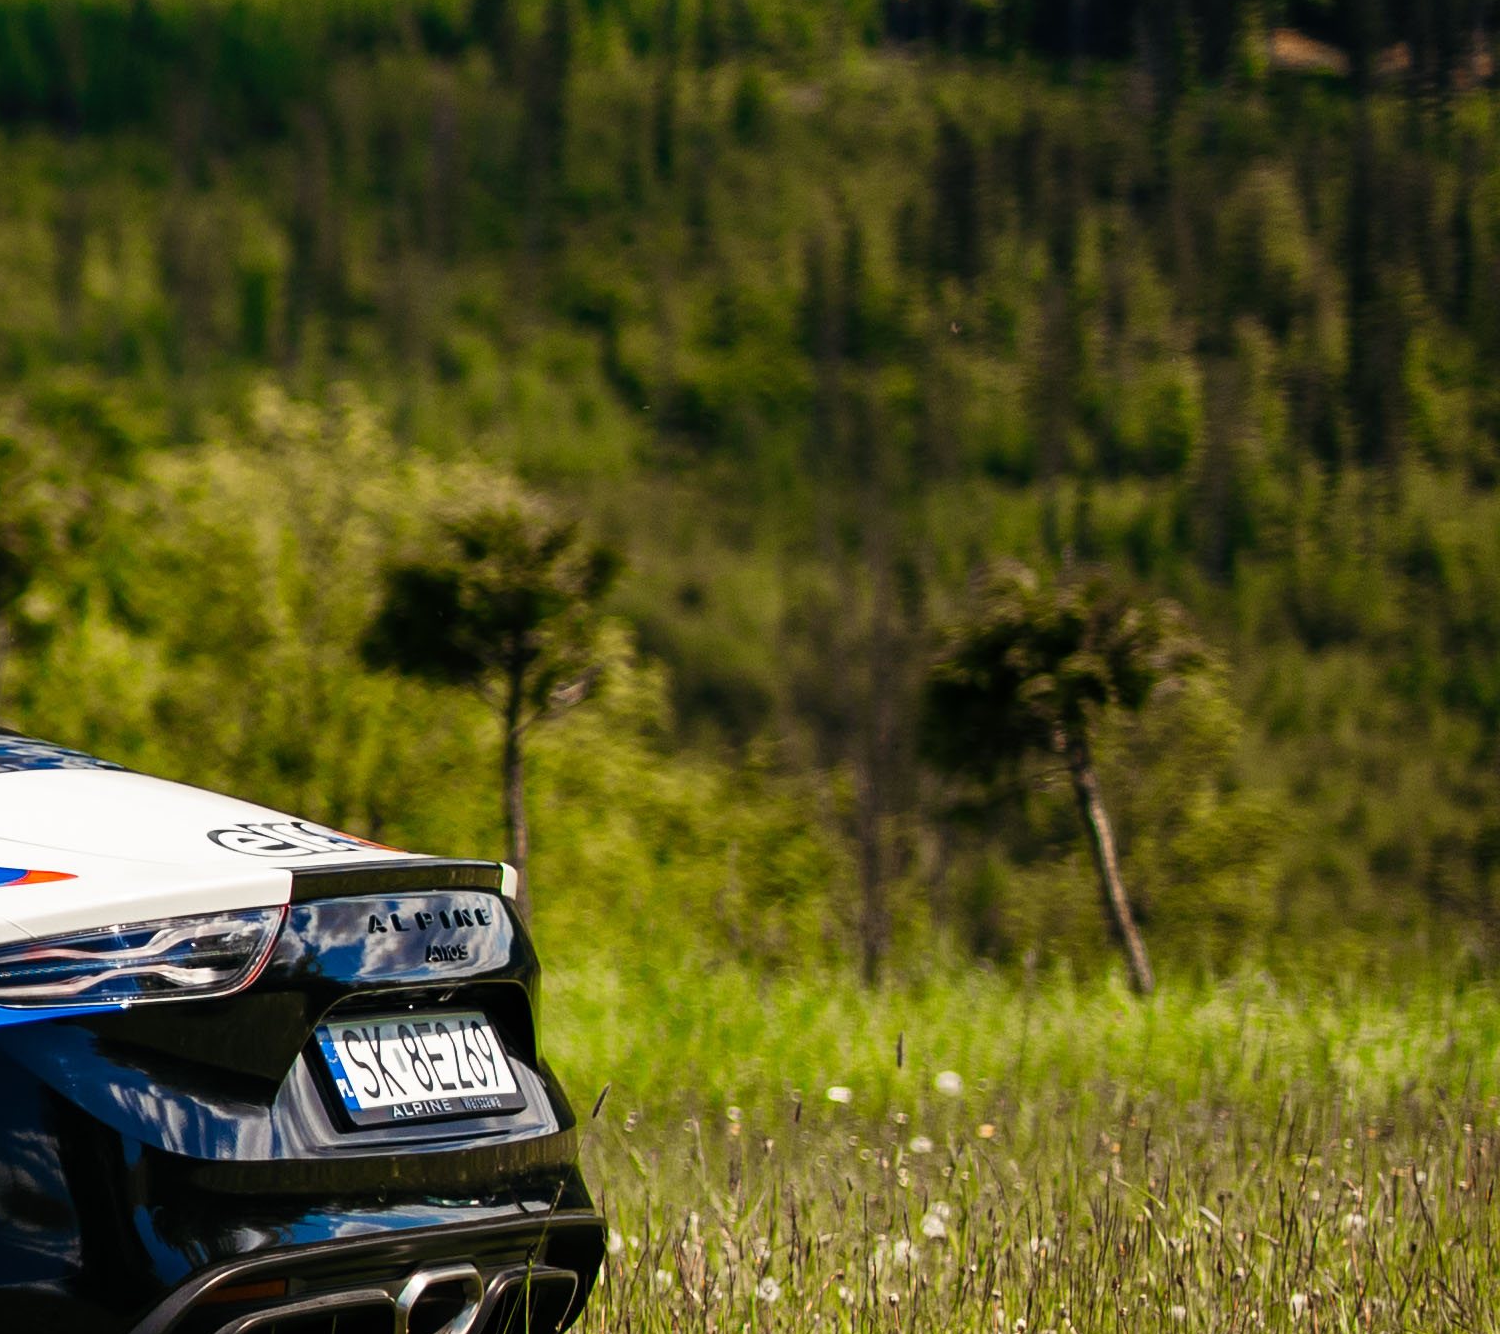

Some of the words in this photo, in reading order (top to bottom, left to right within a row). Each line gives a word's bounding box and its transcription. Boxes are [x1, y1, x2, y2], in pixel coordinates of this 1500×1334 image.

[368, 908, 492, 935] ALPINE
[342, 1025, 408, 1099] SK
[396, 1020, 500, 1093] 8E269
[336, 1077, 355, 1099] PL
[393, 1098, 453, 1118] ALPINE
